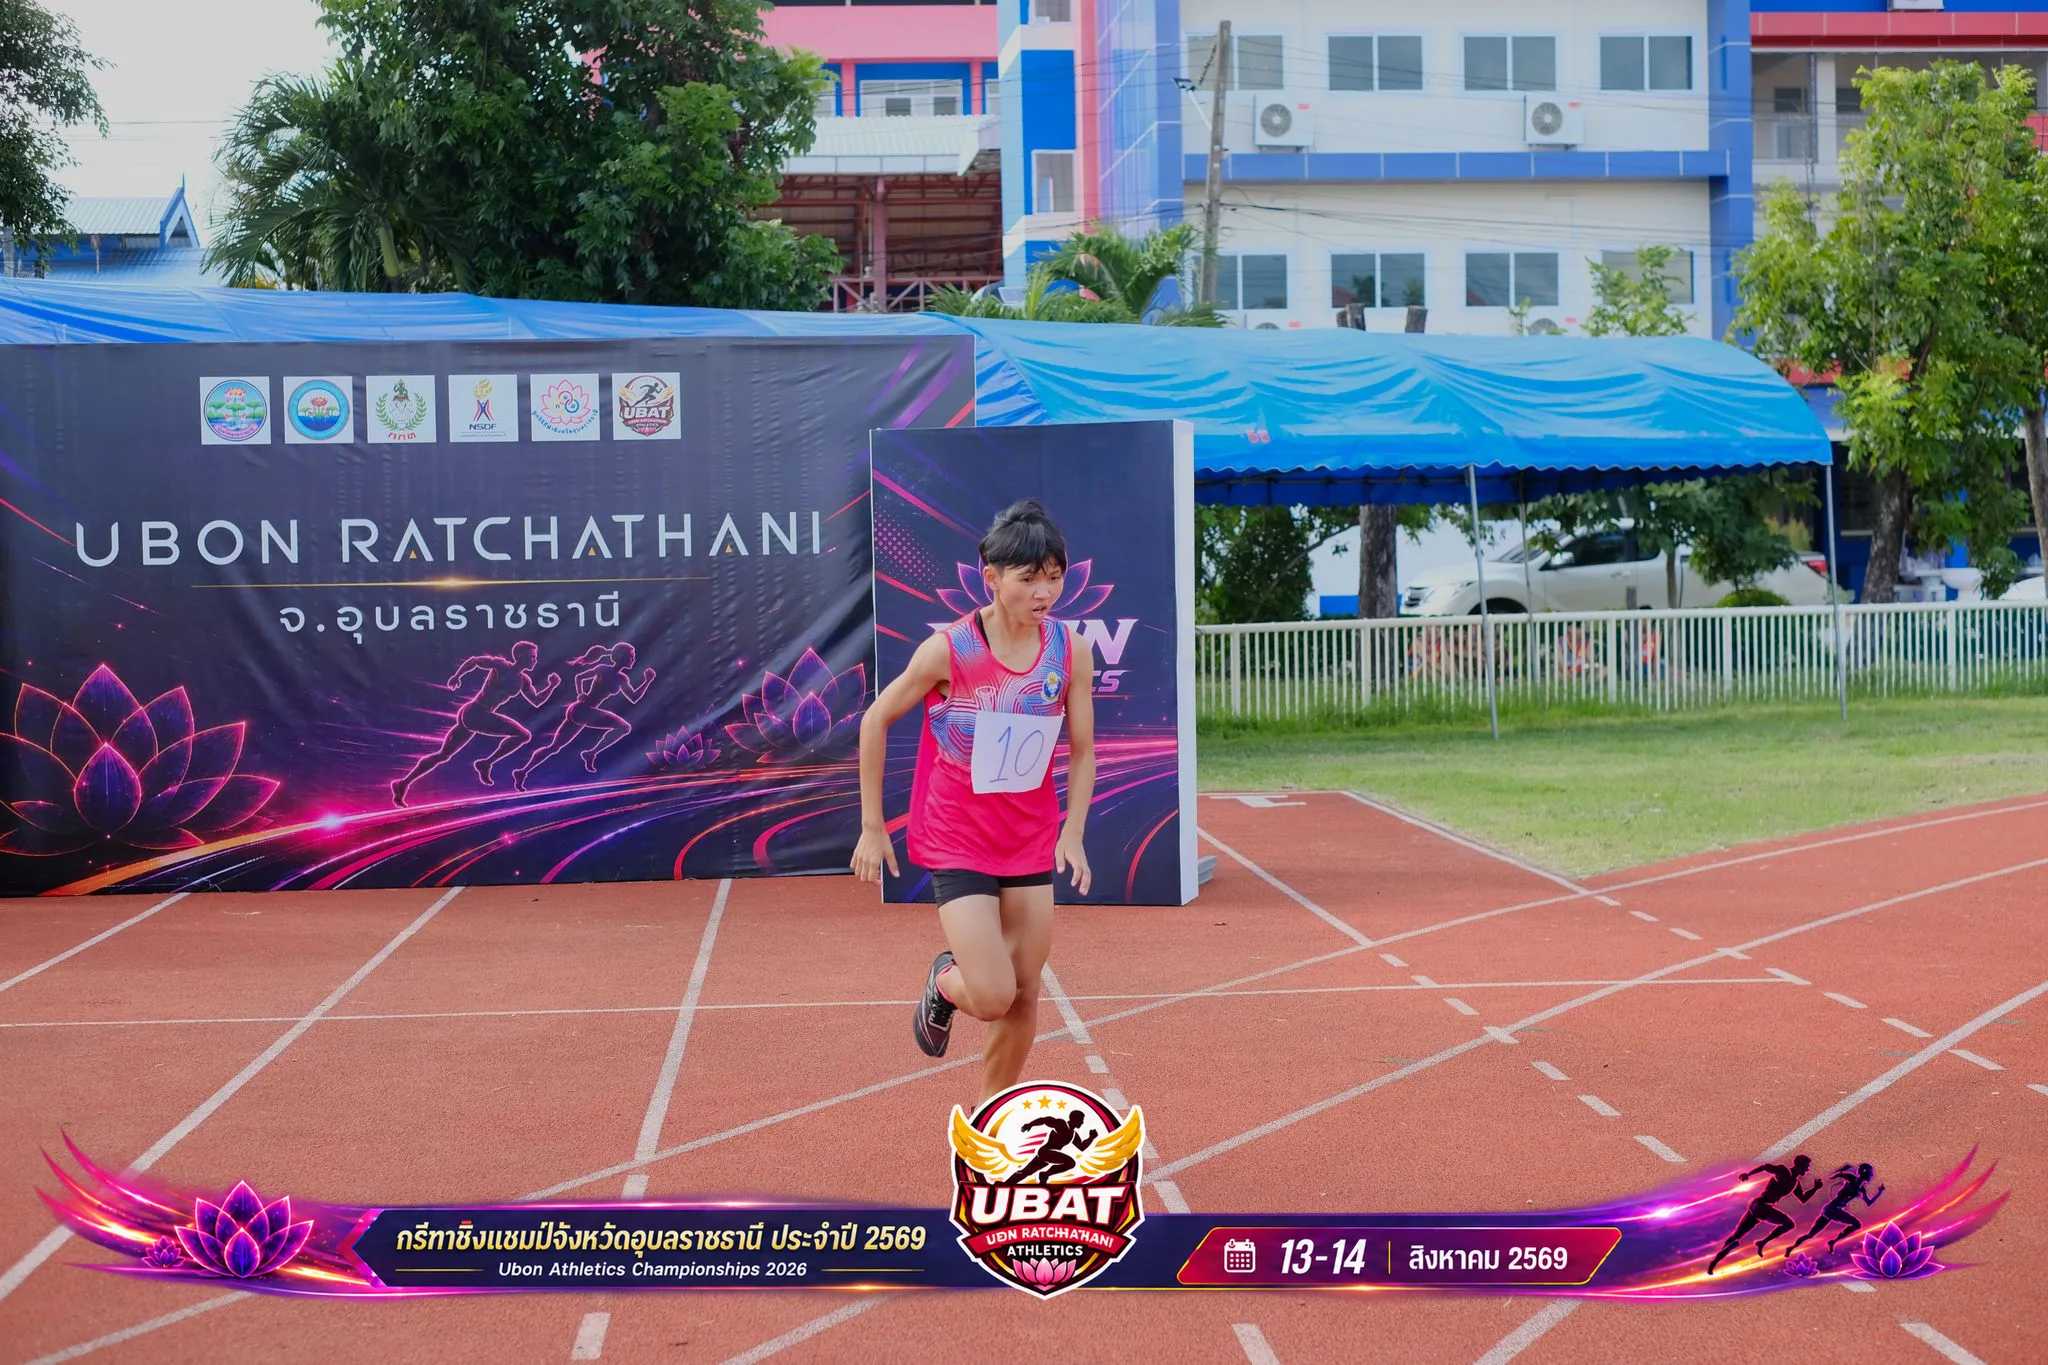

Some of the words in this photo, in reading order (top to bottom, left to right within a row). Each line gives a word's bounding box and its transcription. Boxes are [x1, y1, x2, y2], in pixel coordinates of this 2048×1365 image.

[623, 406, 670, 418] UBAT
[75, 519, 301, 567] UBON
[341, 511, 821, 564] RATCHATHANI
[279, 590, 620, 645] จ.อุบลราชธานี
[989, 725, 1045, 783] 10
